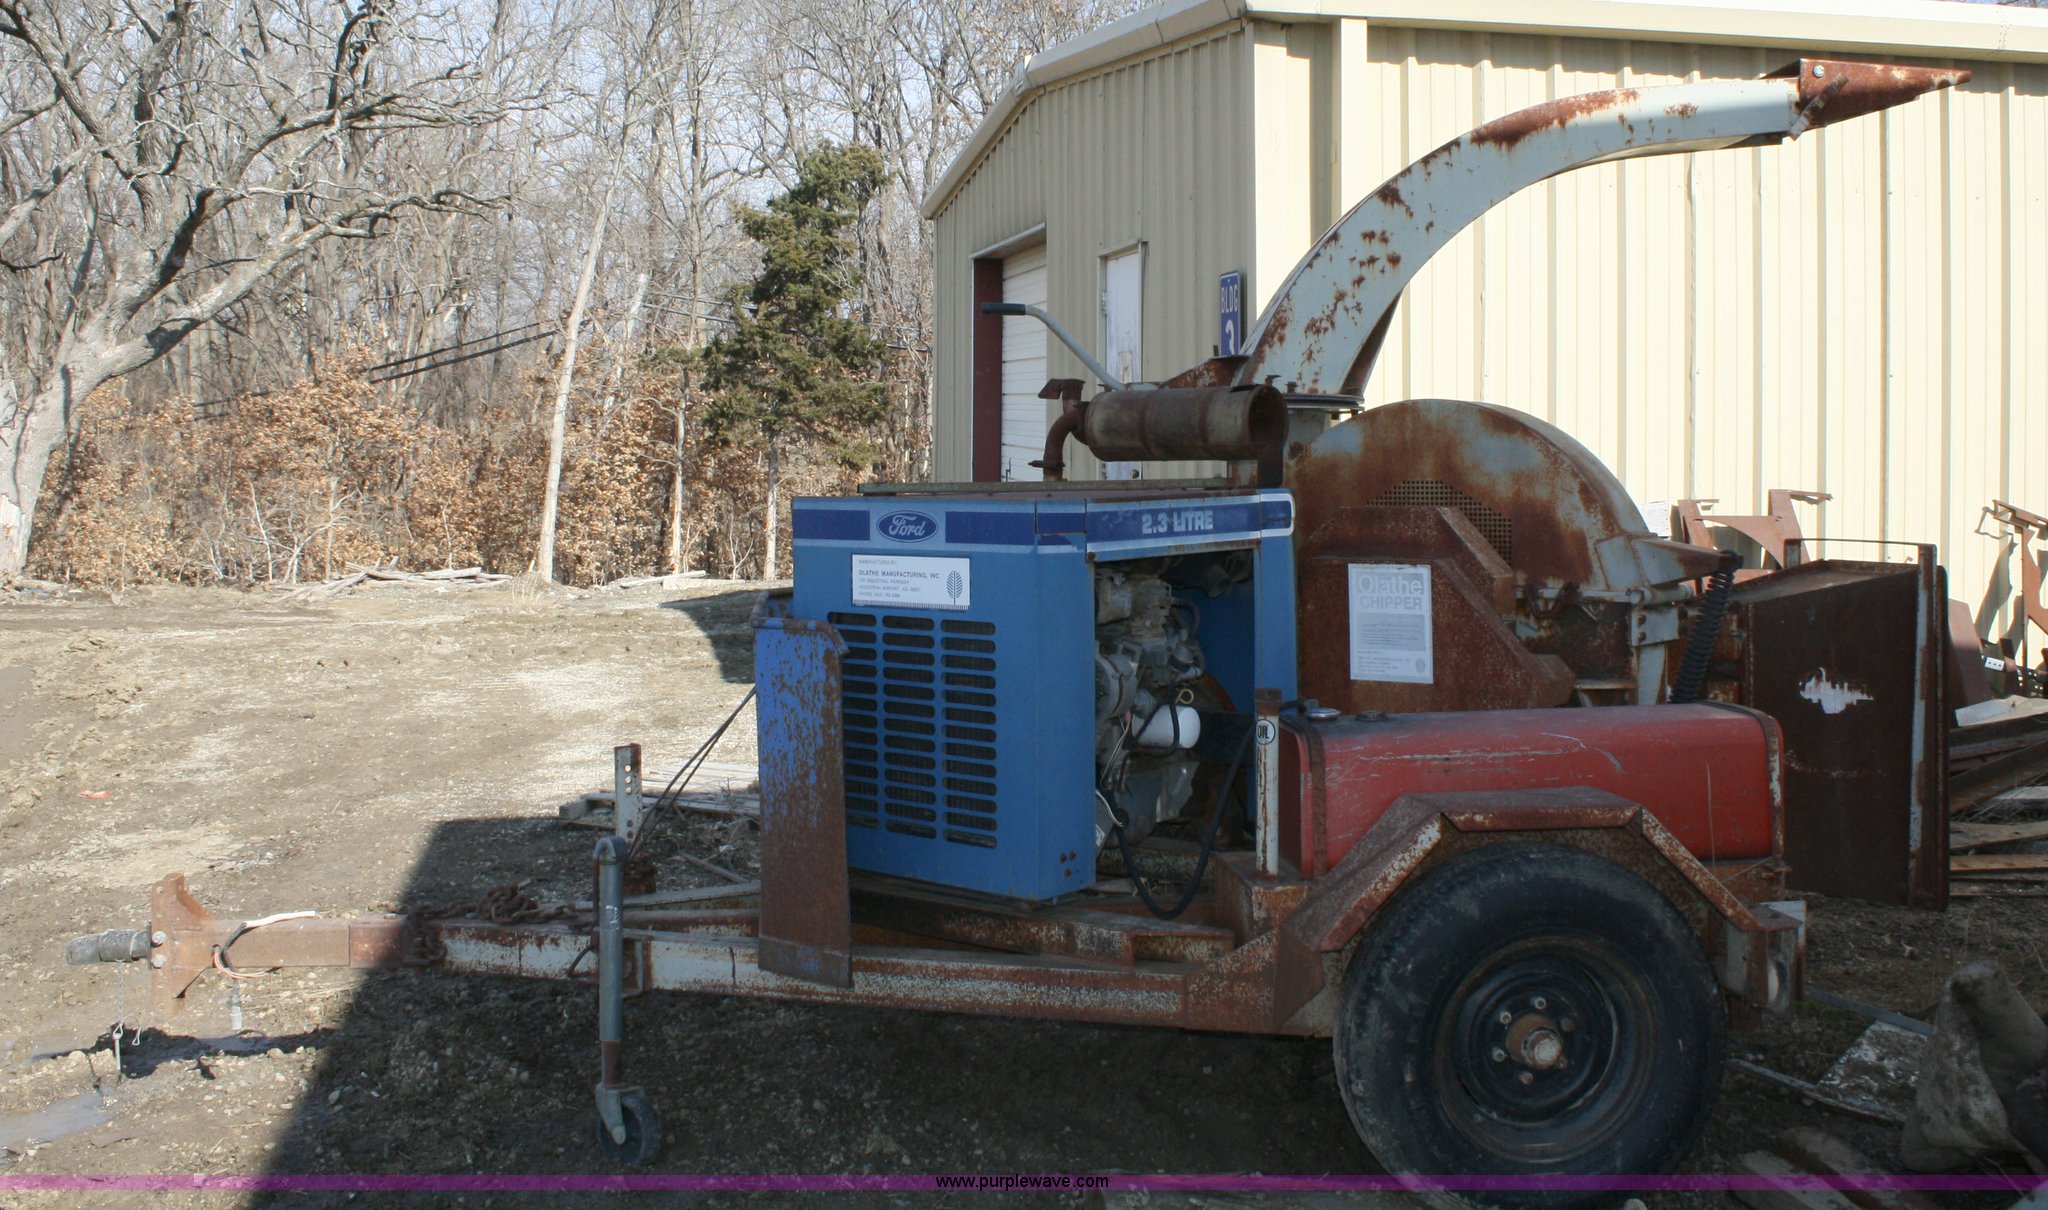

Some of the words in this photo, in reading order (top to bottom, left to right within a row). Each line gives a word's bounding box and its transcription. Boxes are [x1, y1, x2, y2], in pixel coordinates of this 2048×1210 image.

[1221, 284, 1238, 313] BLDG
[888, 514, 926, 536] Ford
[1142, 512, 1168, 534] 2.3
[1173, 510, 1214, 532] LITRE
[858, 569, 879, 577] OLATHE
[881, 570, 928, 579] MANUFACTURING,
[1359, 574, 1422, 594] Olathe
[1360, 595, 1422, 610] CHIPPER
[1257, 725, 1270, 740] OIL
